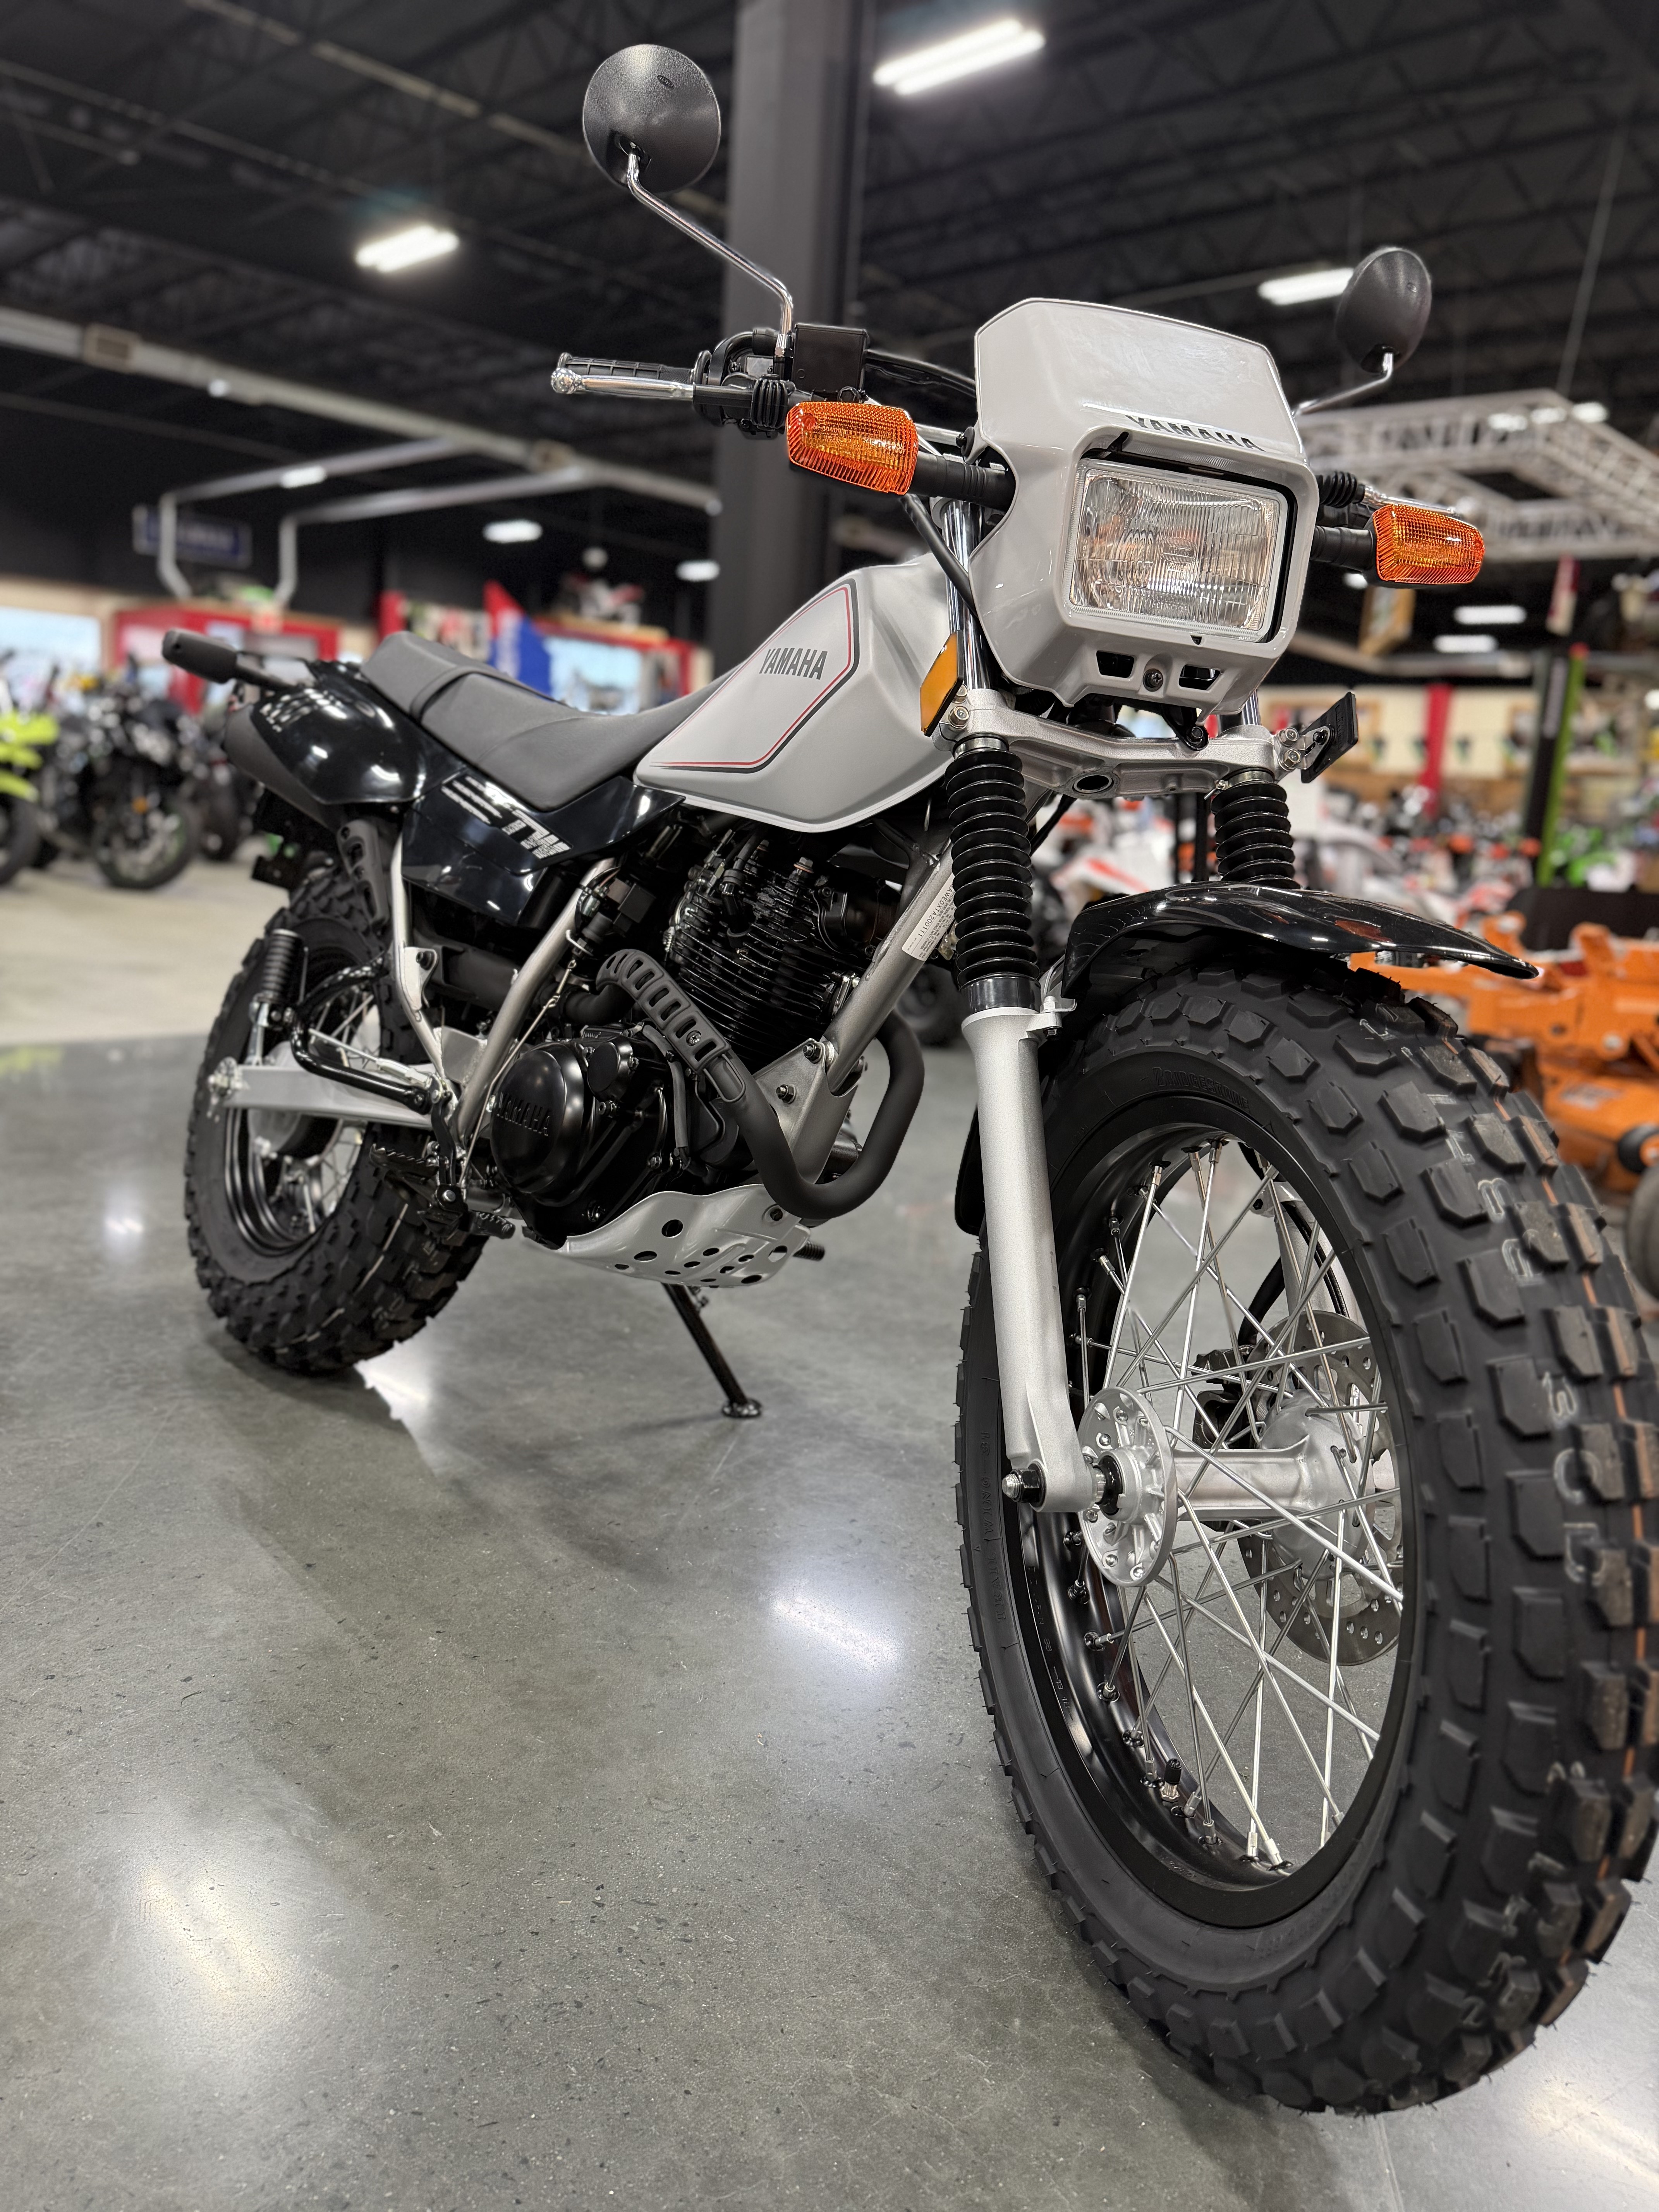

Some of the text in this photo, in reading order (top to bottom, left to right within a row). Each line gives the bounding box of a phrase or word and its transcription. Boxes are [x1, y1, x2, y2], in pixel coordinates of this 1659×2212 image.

[1125, 414, 1266, 452] YAMAHA
[759, 647, 828, 680] YAMAHA
[1152, 1066, 1251, 1111] BRIDGESTONE
